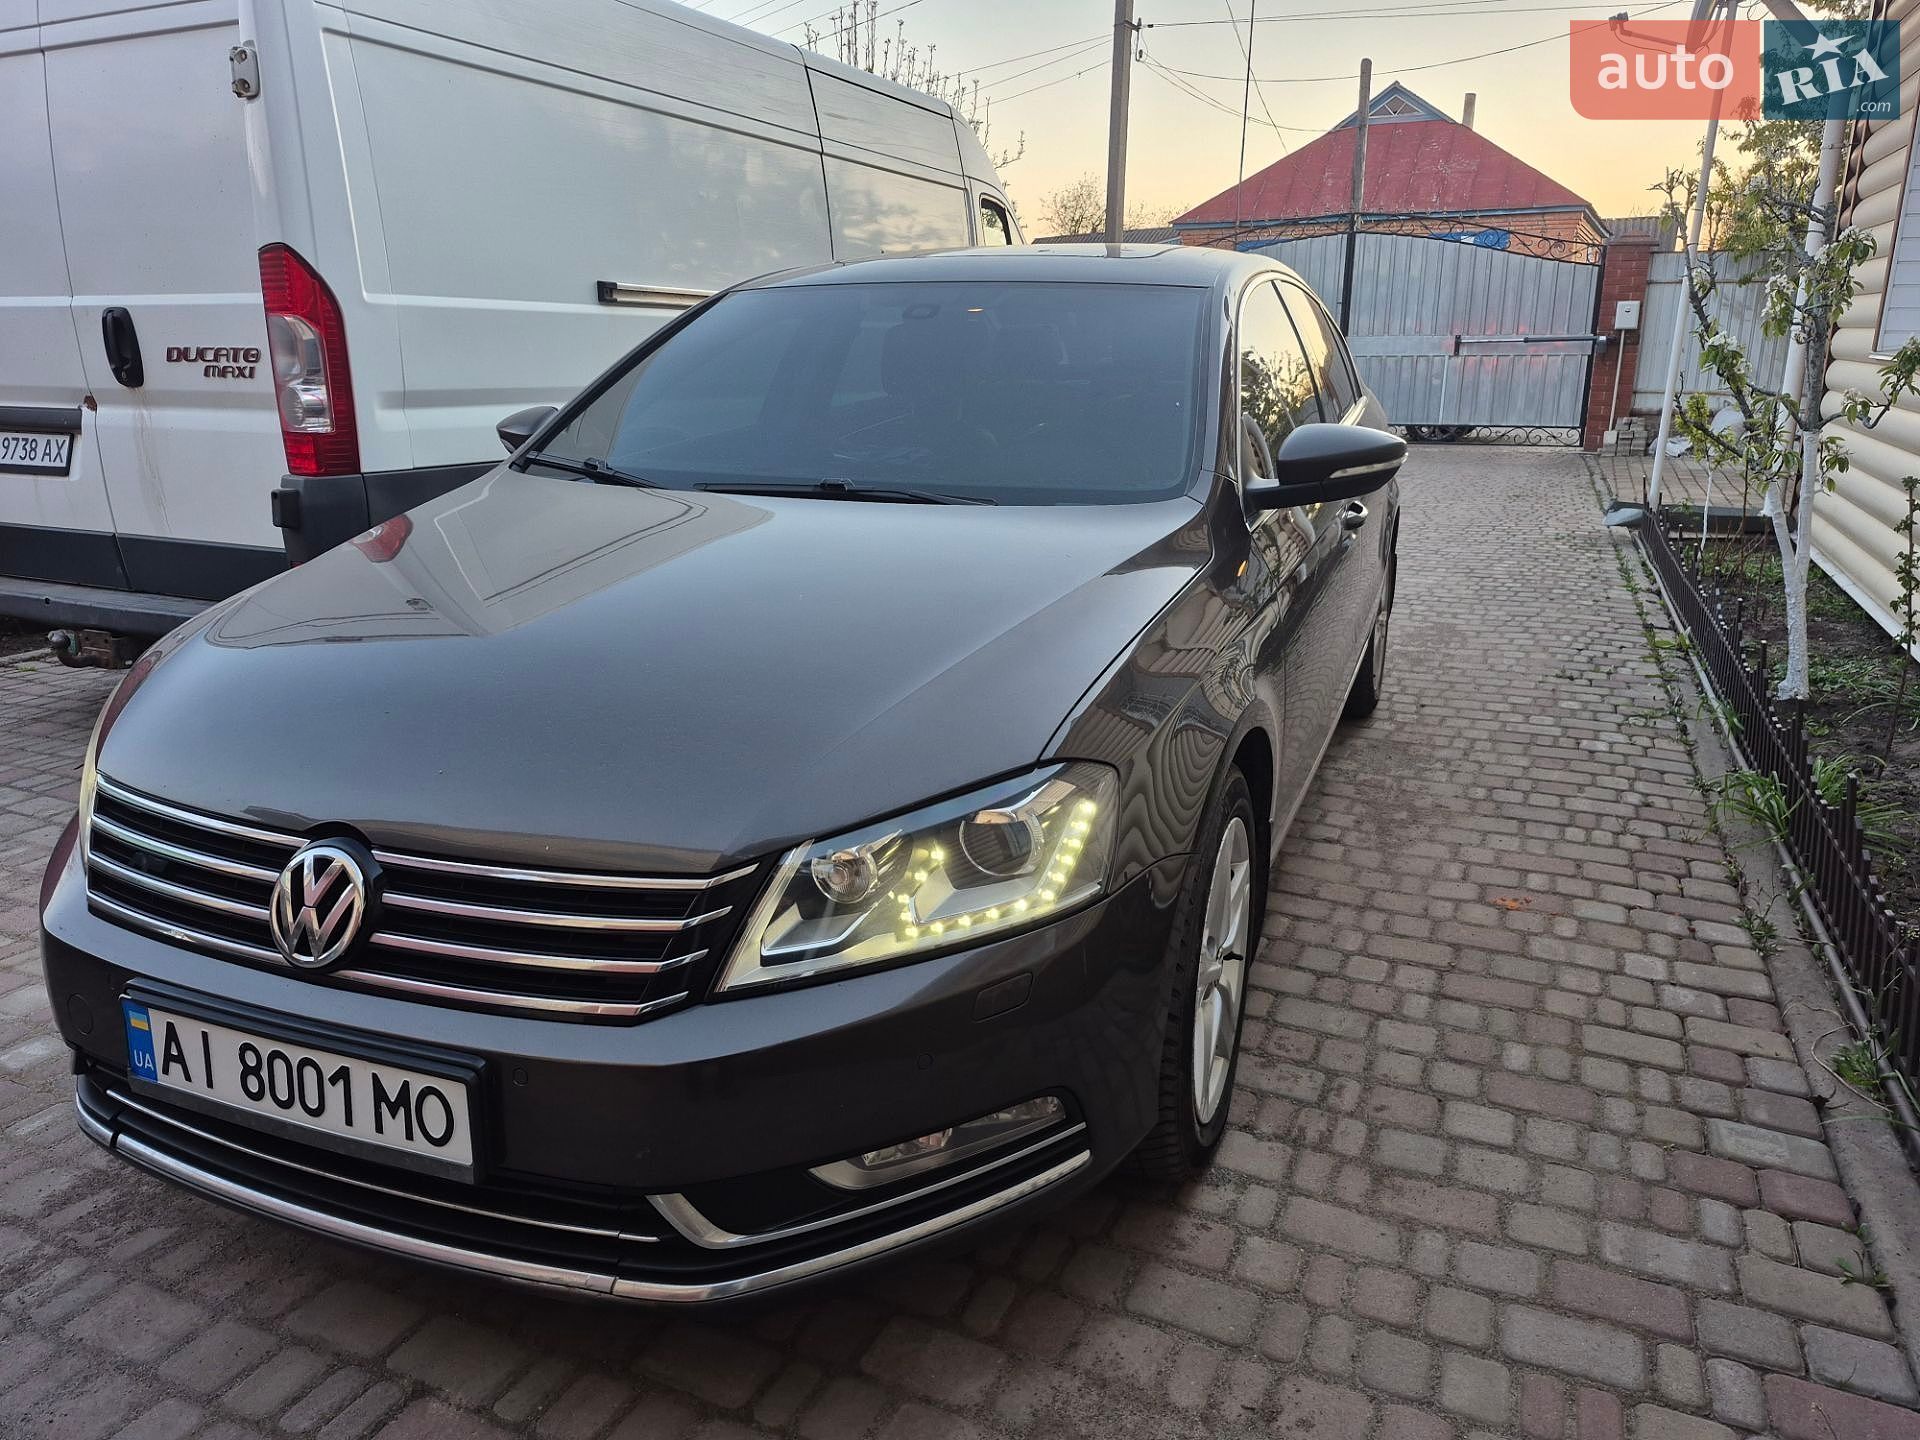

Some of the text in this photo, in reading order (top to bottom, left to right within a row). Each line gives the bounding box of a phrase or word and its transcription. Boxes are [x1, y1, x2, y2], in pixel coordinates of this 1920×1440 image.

[166, 346, 261, 364] DUCATO
[203, 365, 256, 379] MAXI
[1, 437, 66, 464] 9738 AX
[134, 1049, 154, 1070] UA
[161, 1020, 455, 1148] AI 8001 MO
